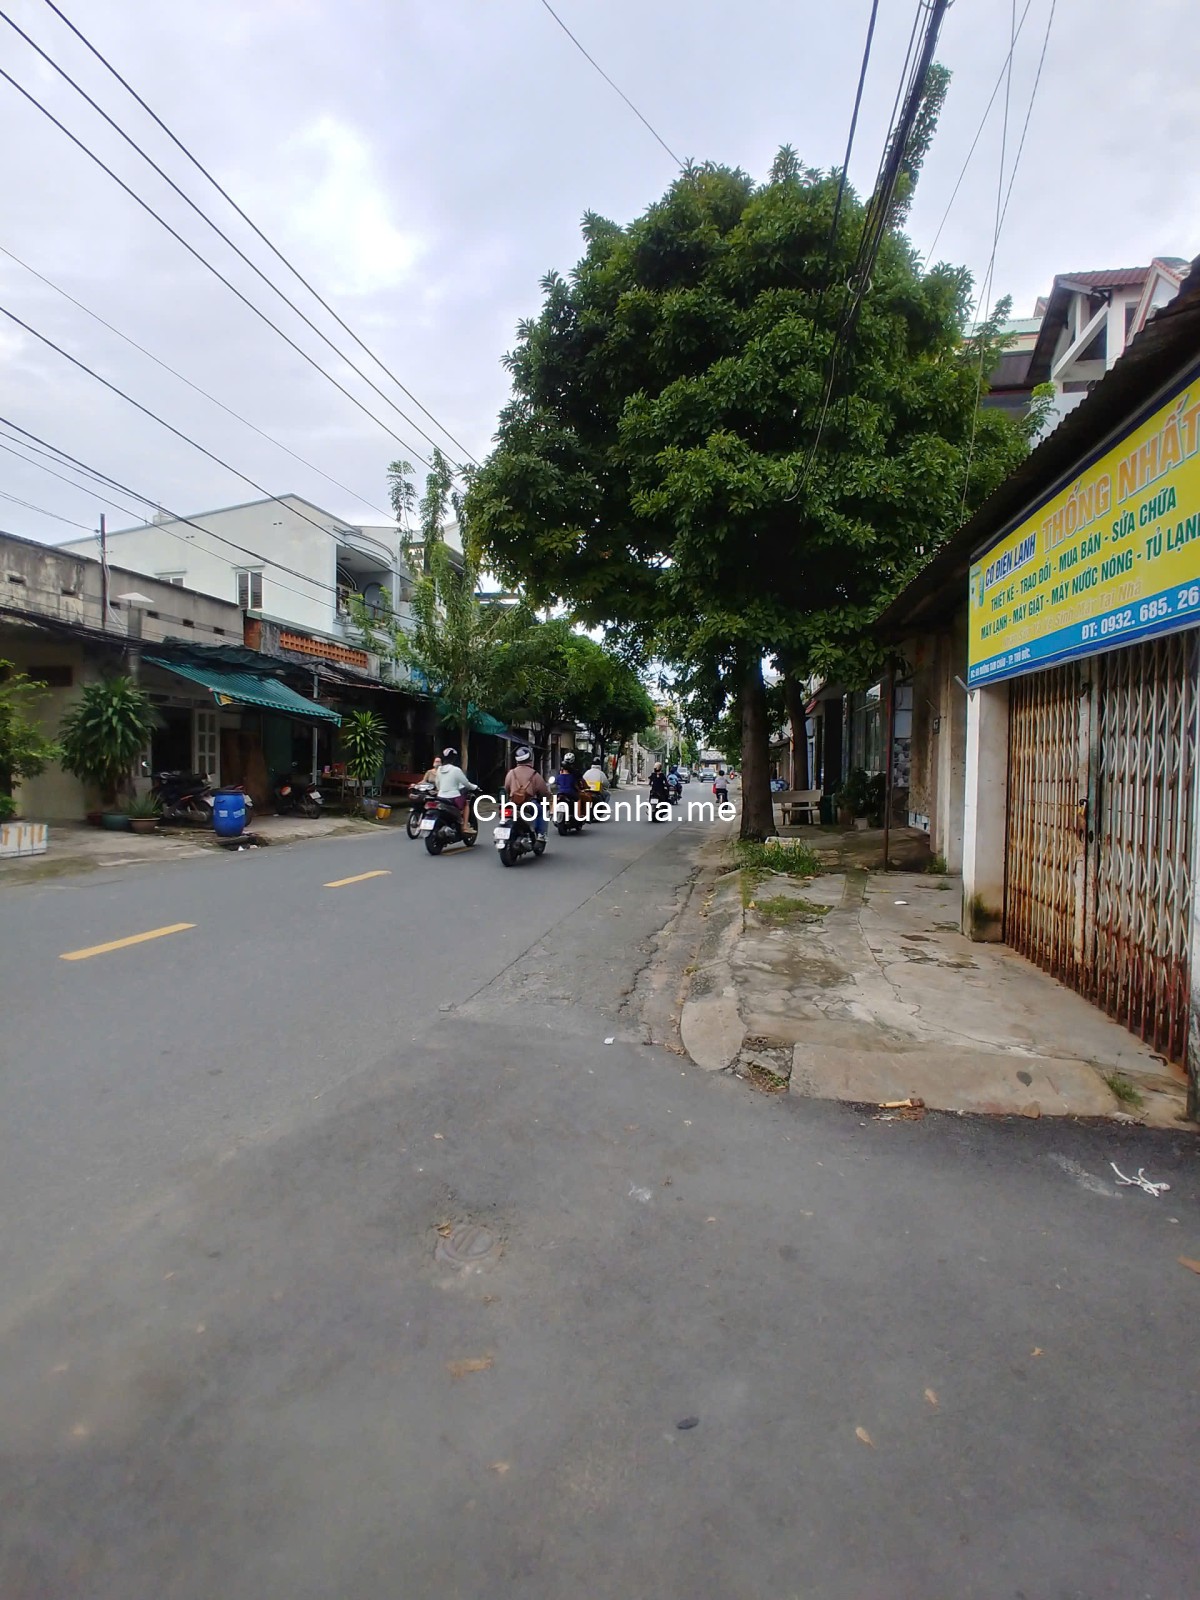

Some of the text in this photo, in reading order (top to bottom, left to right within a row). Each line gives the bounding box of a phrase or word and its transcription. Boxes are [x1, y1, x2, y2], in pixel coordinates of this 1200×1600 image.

[1014, 532, 1036, 568] LẠNH
[1042, 480, 1111, 553] THỐNG
[1118, 394, 1200, 505] NHẤT
[981, 621, 992, 640] MÁY
[993, 614, 1008, 636] LẠNH
[1013, 603, 1026, 624] MÁY
[1028, 593, 1045, 616] GIẶT
[1052, 581, 1070, 606] MÁY
[1072, 566, 1098, 595] NƯỚC
[1101, 549, 1133, 582] NÓNG
[1146, 526, 1162, 561] TỦ
[1020, 572, 1037, 595] TRAO
[1039, 558, 1052, 583] ĐỔI
[1059, 547, 1078, 572] MUA
[1080, 532, 1101, 560] BÁN
[1112, 510, 1135, 542] SỬA
[1139, 486, 1177, 527] CHỮA
[1081, 623, 1098, 640] ĐT:
[1101, 609, 1135, 635] 0932.
[1140, 596, 1172, 622] 685.
